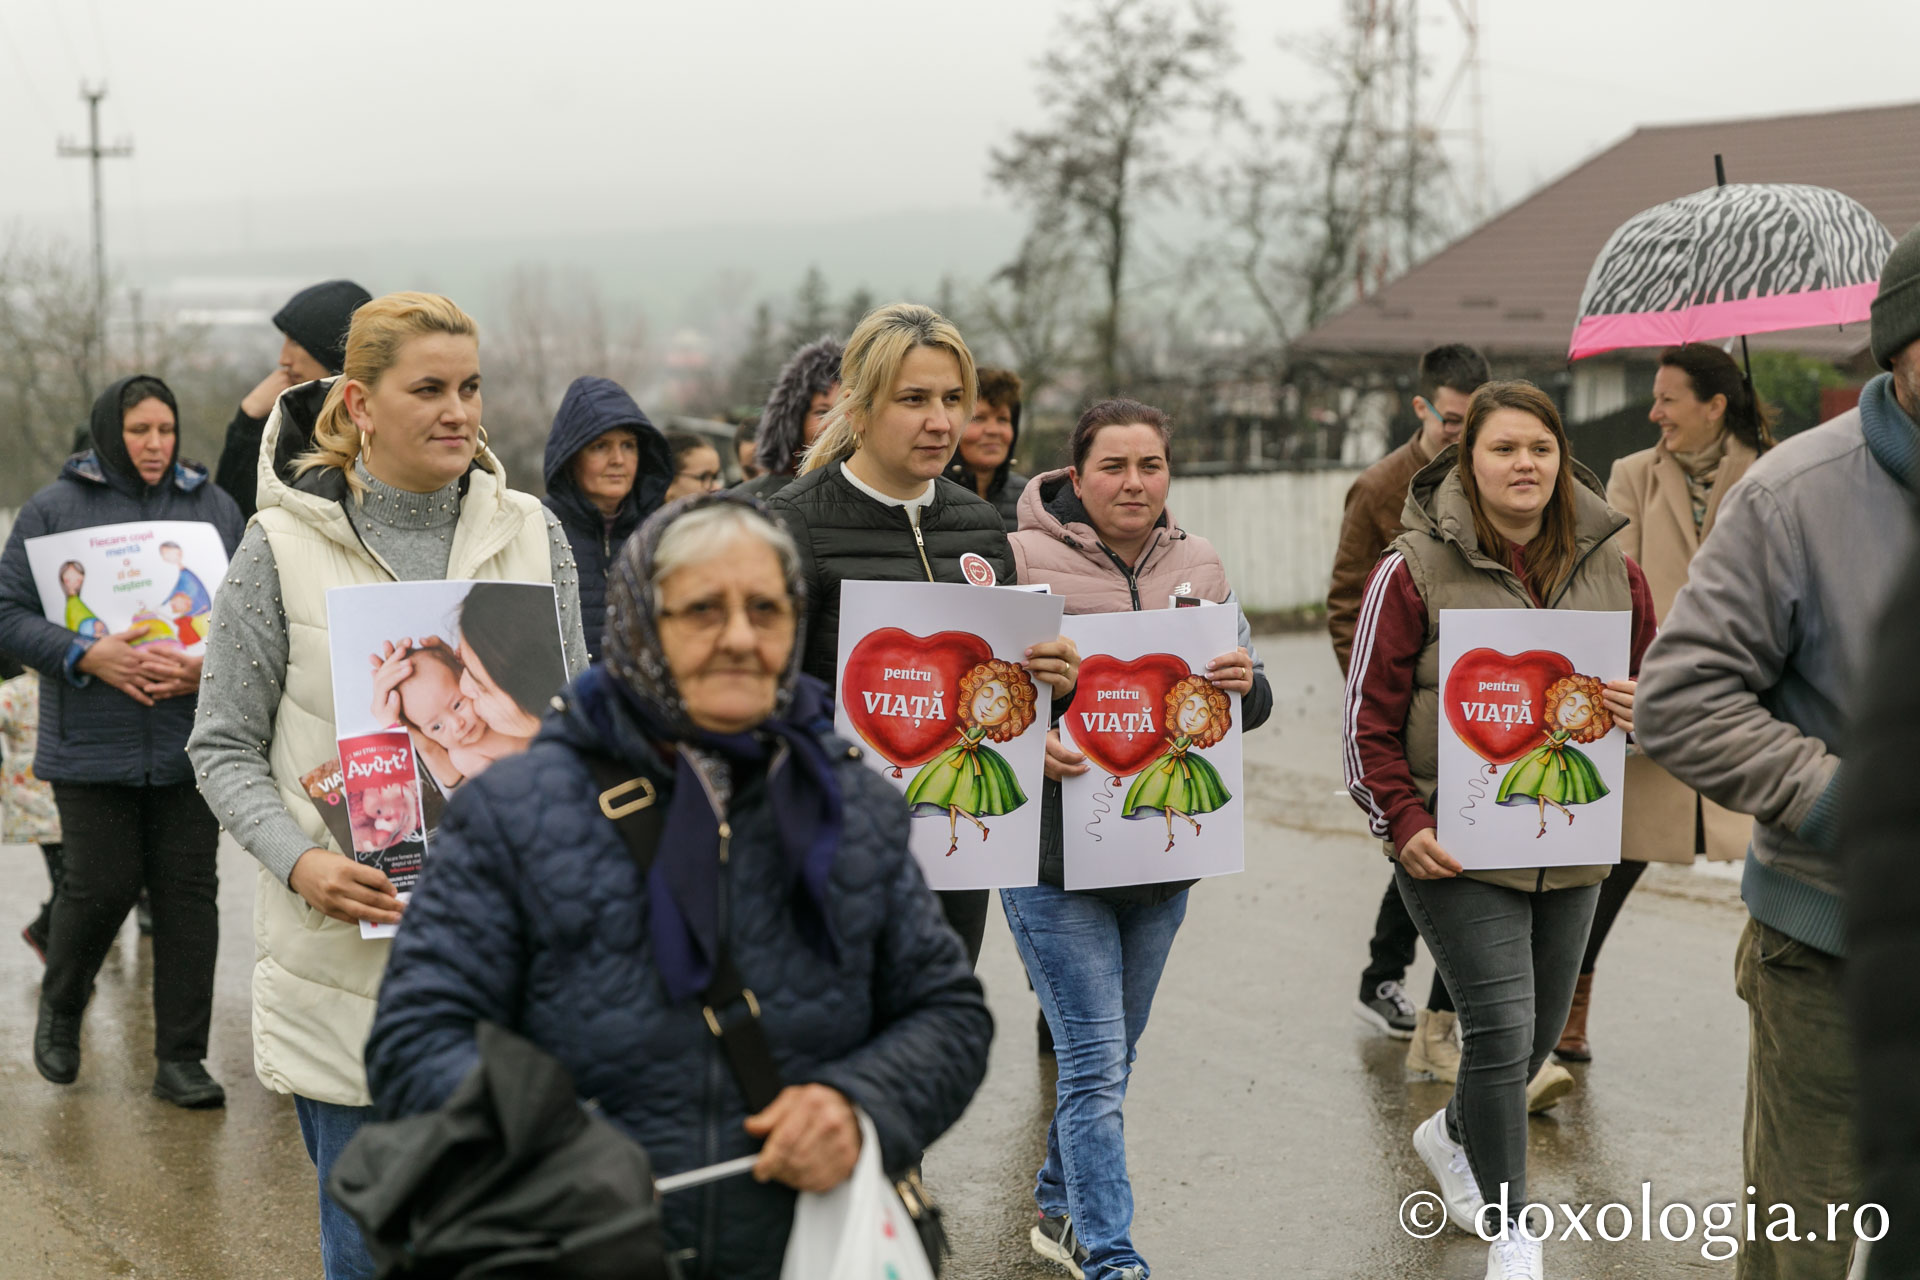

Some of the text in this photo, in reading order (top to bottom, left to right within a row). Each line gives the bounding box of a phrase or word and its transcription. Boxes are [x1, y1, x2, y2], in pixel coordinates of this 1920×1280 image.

[89, 535, 127, 548] Fiecare
[883, 667, 932, 682] pentru
[1478, 680, 1520, 693] pentru
[1097, 688, 1140, 702] pentru
[862, 690, 947, 728] VIAȚĂ
[1460, 699, 1535, 732] VIAȚĂ
[1080, 706, 1156, 742] VIAȚĂ
[346, 747, 408, 780] Avort?
